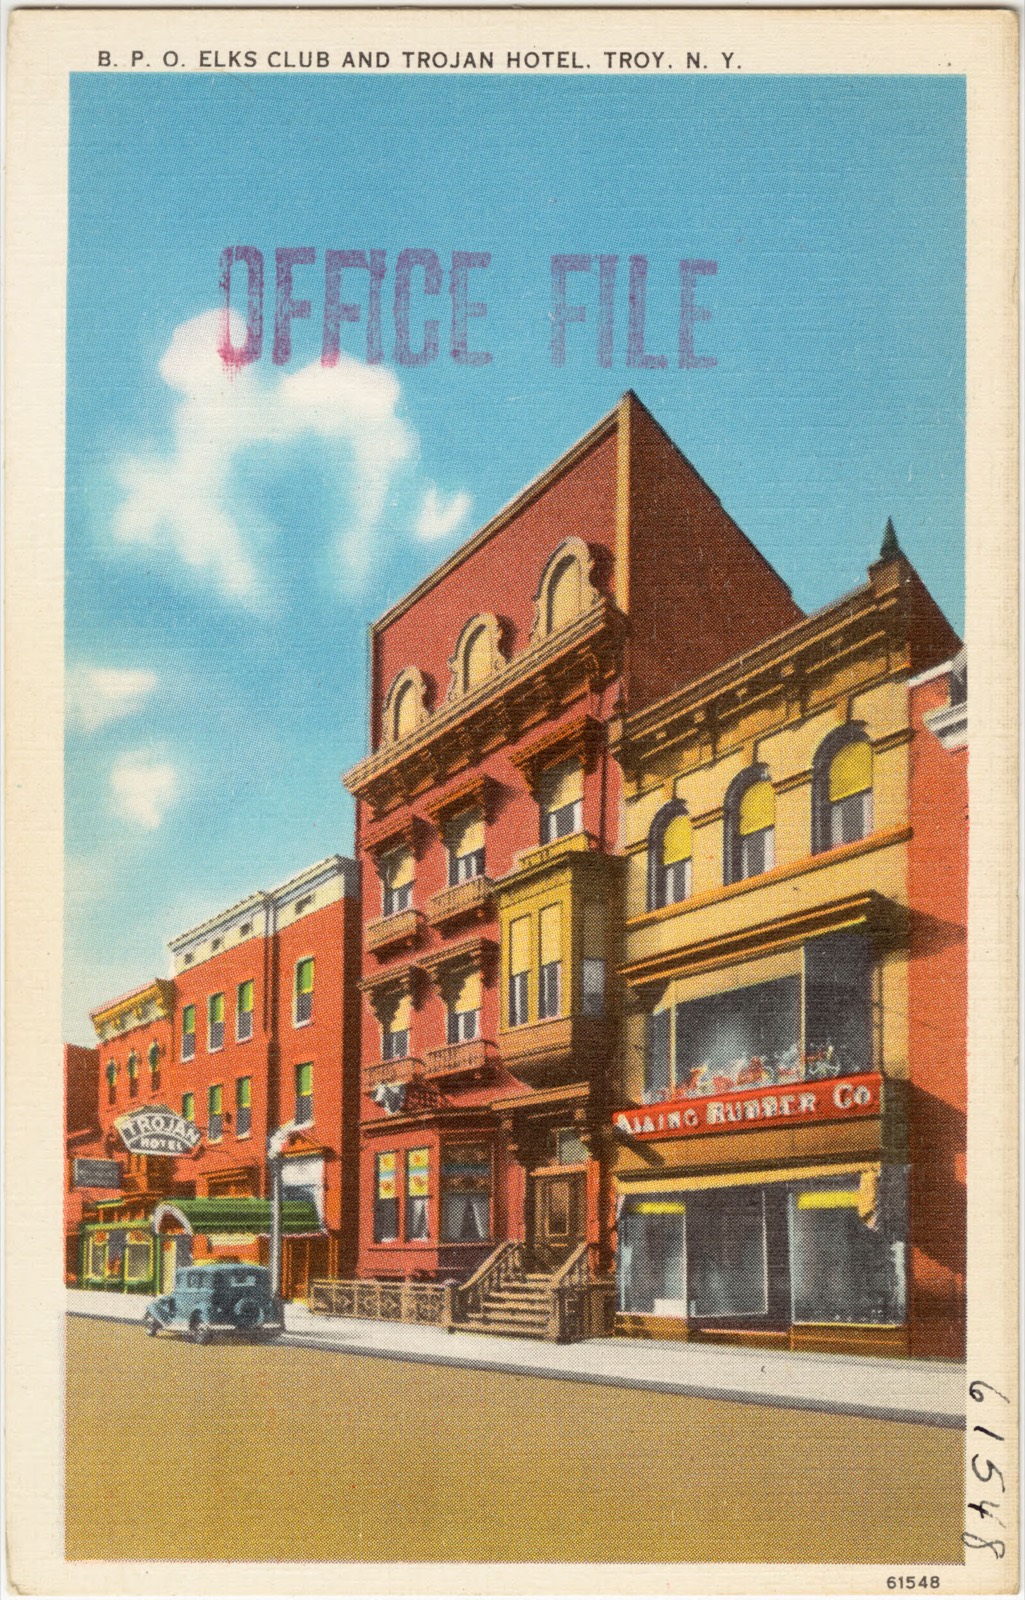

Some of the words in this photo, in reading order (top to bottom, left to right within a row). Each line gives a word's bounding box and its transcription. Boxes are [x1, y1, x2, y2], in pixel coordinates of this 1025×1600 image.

[217, 245, 493, 372] OFFICE
[548, 253, 719, 370] FILE
[706, 1092, 817, 1126] RUBBER
[119, 1112, 202, 1146] TROJAN
[140, 1137, 184, 1151] HOTEL
[961, 1380, 1011, 1560] 61548
